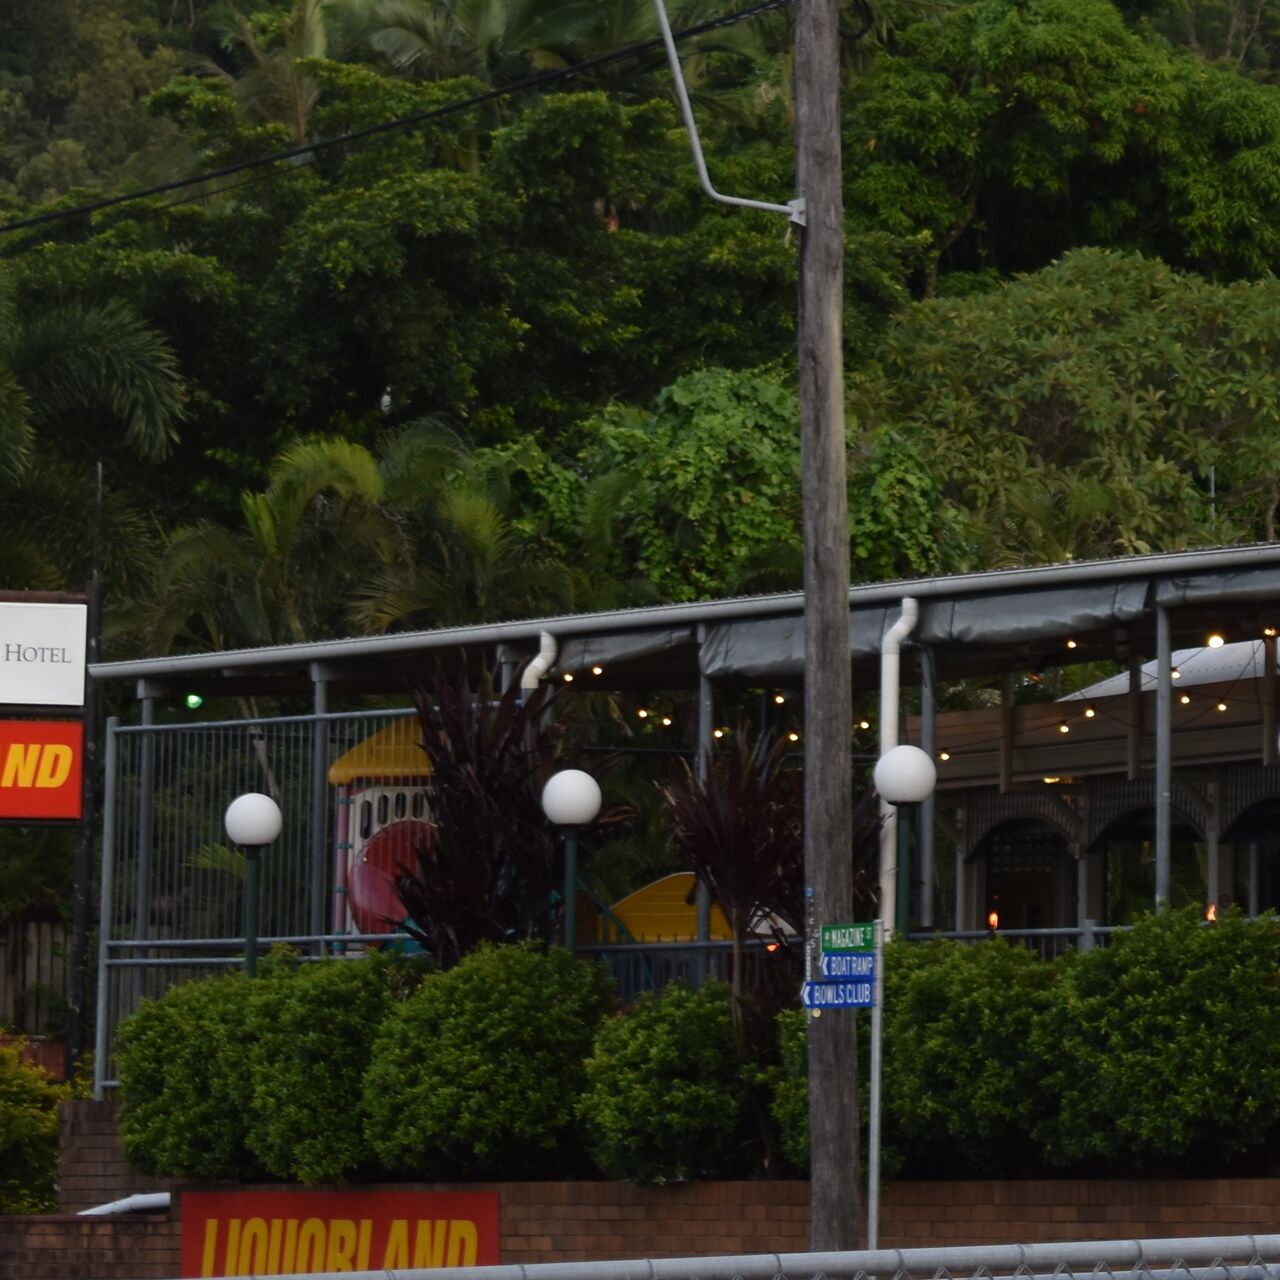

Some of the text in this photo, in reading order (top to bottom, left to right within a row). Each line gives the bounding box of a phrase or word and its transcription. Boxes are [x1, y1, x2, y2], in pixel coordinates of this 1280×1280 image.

[831, 927, 865, 949] MAGAZINE
[831, 956, 873, 975] BOAT RAMP
[814, 983, 870, 1005] BOWLS CLUB
